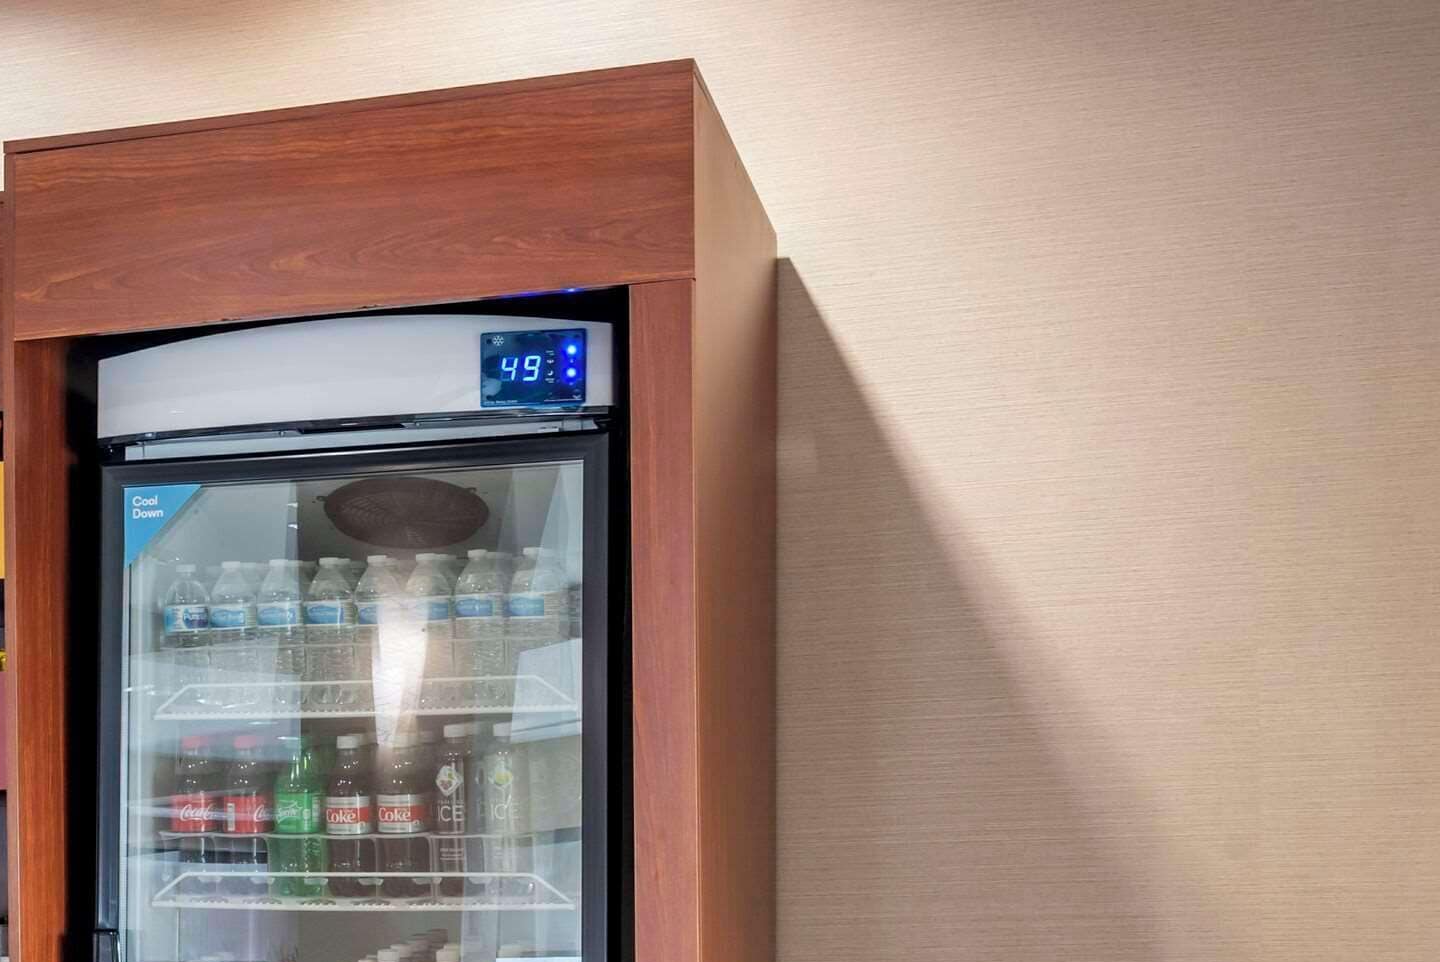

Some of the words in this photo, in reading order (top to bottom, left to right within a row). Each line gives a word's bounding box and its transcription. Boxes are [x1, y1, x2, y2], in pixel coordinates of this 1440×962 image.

[501, 355, 542, 382] 49
[132, 495, 159, 506] Cool
[132, 508, 164, 519] Down
[326, 807, 357, 823] Coke
[378, 807, 411, 822] Coke
[438, 806, 464, 821] ICE
